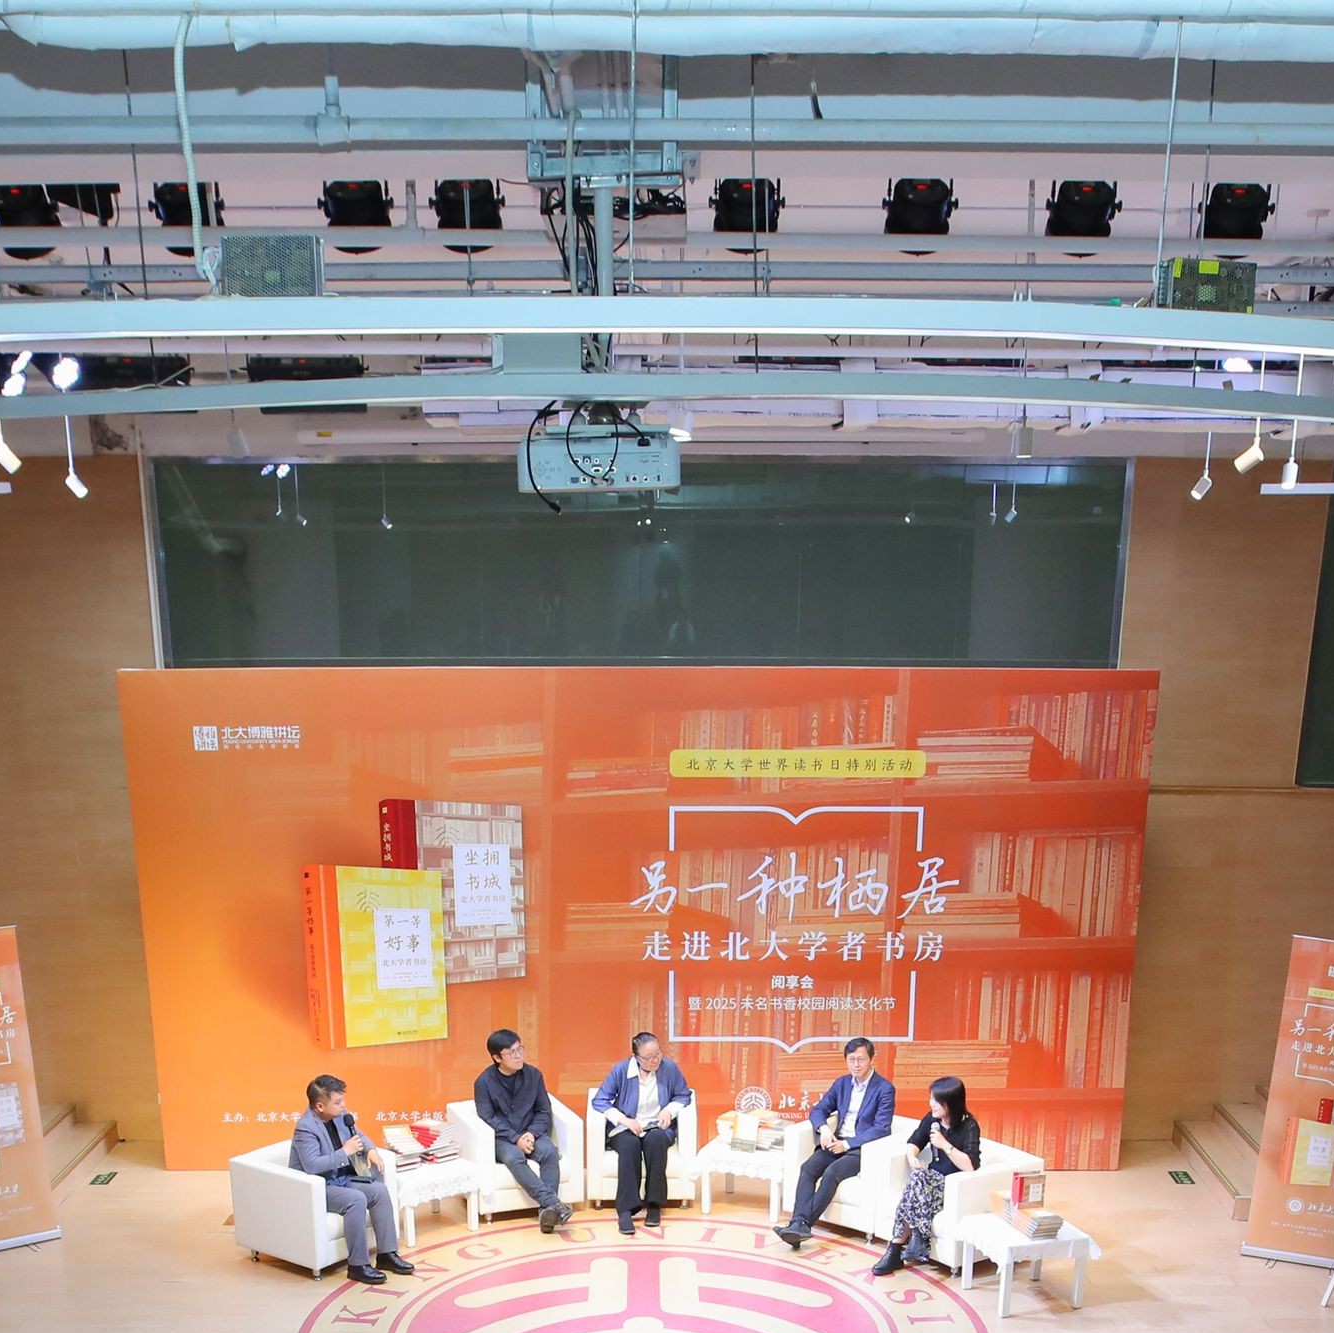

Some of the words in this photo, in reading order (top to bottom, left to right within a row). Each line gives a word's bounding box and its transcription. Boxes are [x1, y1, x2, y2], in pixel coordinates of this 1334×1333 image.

[221, 726, 301, 739] 北大博雅讲坛
[686, 758, 913, 771] 北京大学世界读书日特别活动
[383, 822, 394, 863] 坐拥书城
[465, 849, 500, 866] 坐拥
[465, 873, 502, 891] 书城
[630, 852, 960, 923] 另一种栖居
[460, 894, 506, 904] 北大学者书房
[384, 915, 421, 929] 第一等
[384, 933, 421, 953] 好事
[642, 930, 945, 962] 走进北大学者书房
[381, 958, 428, 968] 北大学者书房
[771, 975, 814, 989] 阅享会
[705, 997, 737, 1010] 2025
[741, 996, 896, 1011] 未名书香校园阅读文化节
